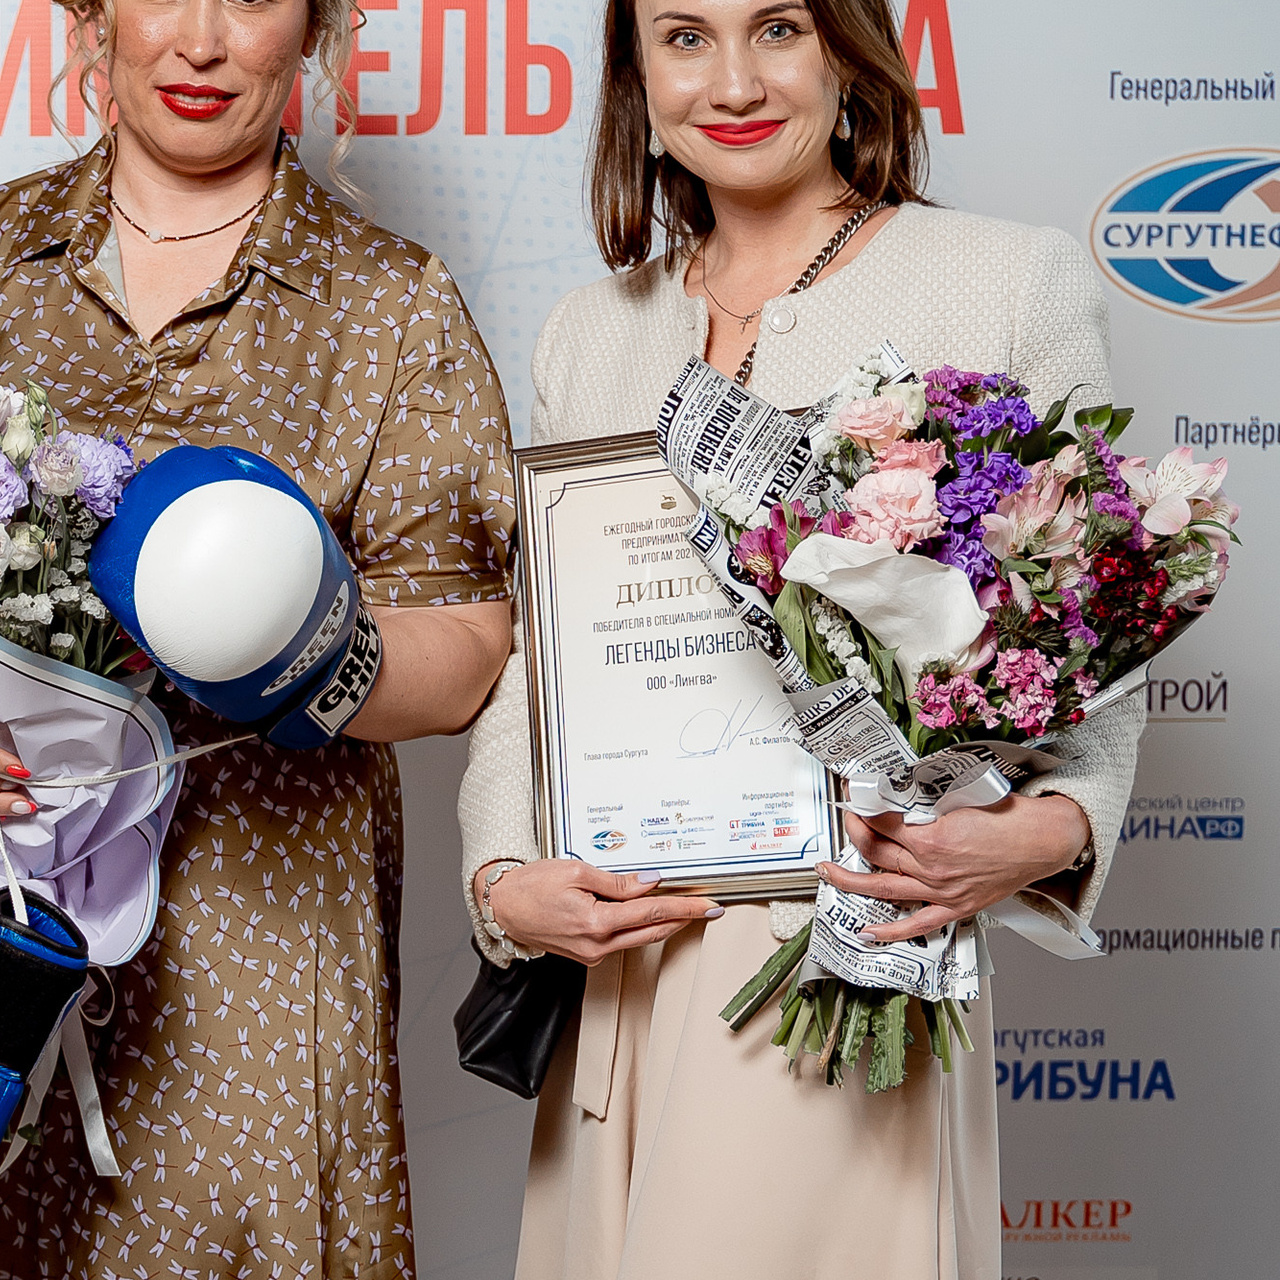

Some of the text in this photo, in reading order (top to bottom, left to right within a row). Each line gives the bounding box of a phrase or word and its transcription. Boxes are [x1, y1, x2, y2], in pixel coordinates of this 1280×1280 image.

[1110, 71, 1276, 107] Генеральный
[726, 385, 750, 405] DE
[690, 399, 742, 475] ROCHEGRE
[604, 521, 654, 537] ЕЖЕГОДНЫЙ
[621, 531, 687, 550] ПРЕДПРИНИМАТ
[628, 548, 696, 566] ПО ИТОГАМ 2021
[616, 574, 721, 609] ДИПЛО
[593, 617, 645, 633] ПОБЕДИТЕЛЯ
[646, 617, 652, 628] В
[654, 608, 712, 626] СПЕЦИАЛЬНОЙ
[269, 596, 343, 689] GREEN
[289, 622, 342, 681] HILL
[605, 630, 757, 666] ЛЕГЕНДЫ БИЗНЕСА
[317, 602, 371, 714] GREE
[646, 673, 718, 691] ООО «Лингва»
[831, 683, 855, 702] DE
[749, 737, 762, 746] А.С.
[583, 748, 649, 762] Глава города Сургута
[1186, 796, 1246, 813] центр
